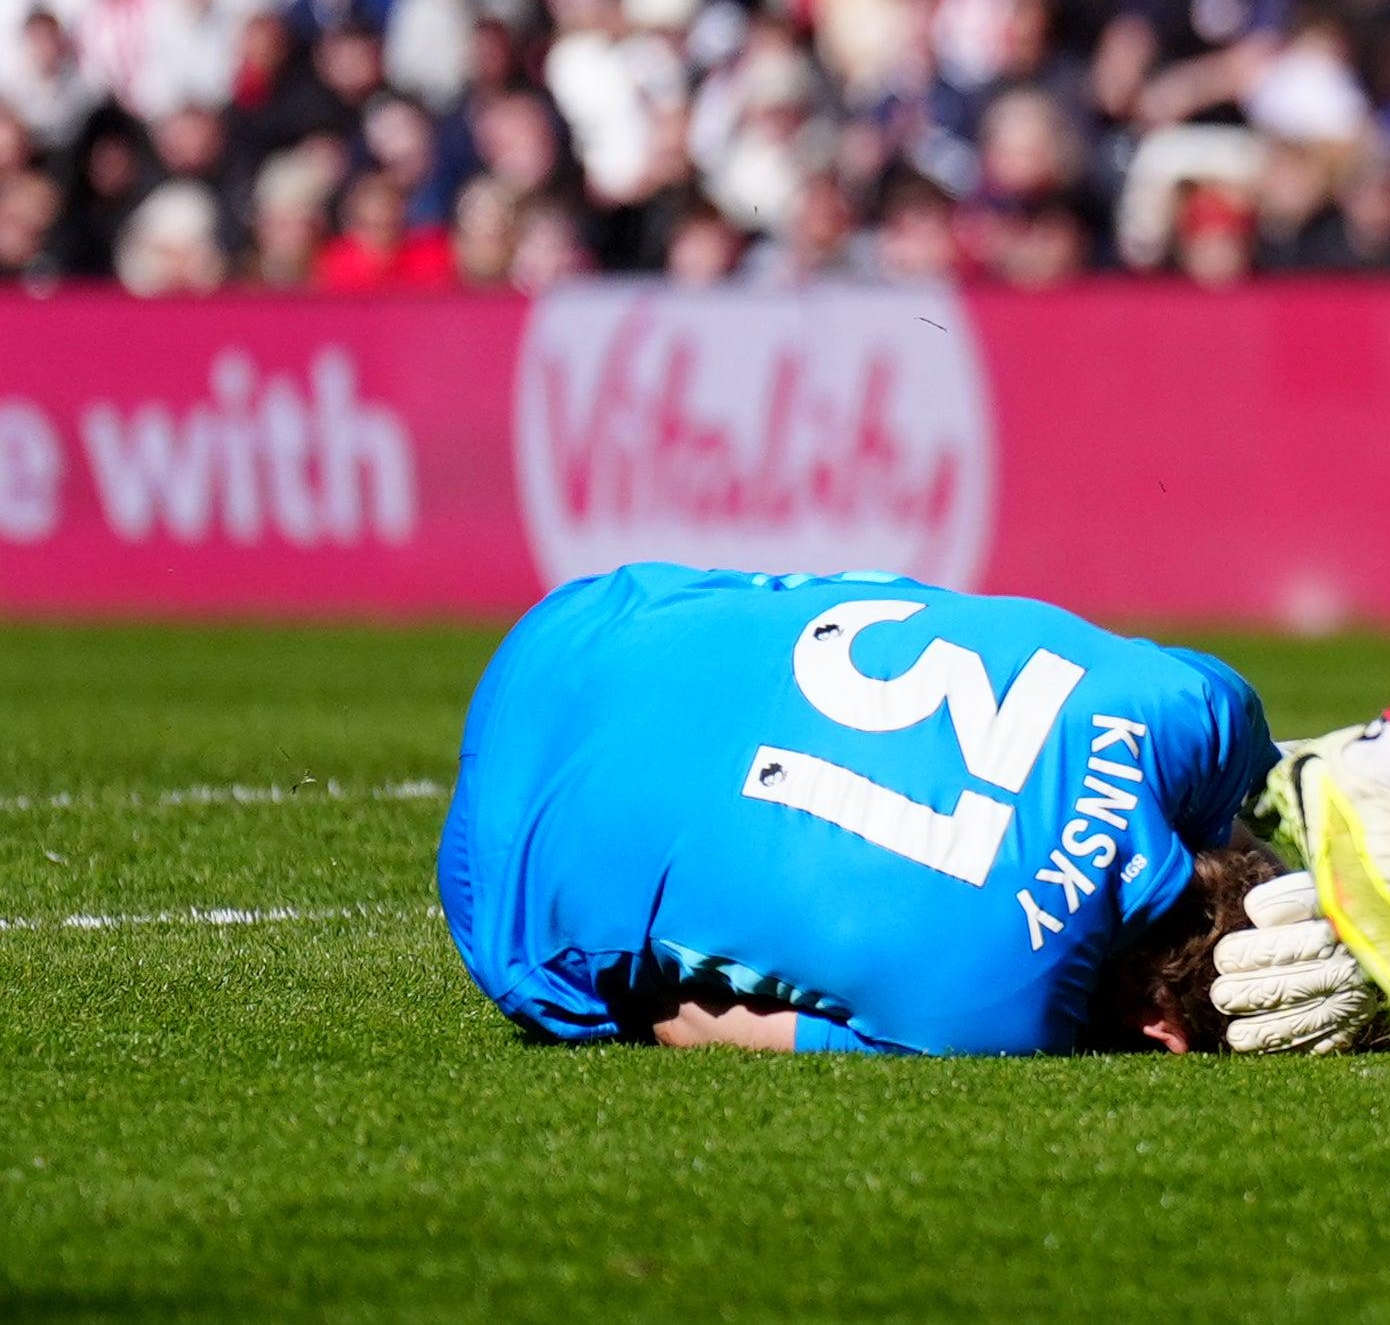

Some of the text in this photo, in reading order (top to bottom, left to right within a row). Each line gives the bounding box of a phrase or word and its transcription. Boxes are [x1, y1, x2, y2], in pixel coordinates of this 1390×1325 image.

[84, 344, 412, 547] with
[741, 599, 1088, 888] 31
[1015, 714, 1147, 951] KINSKY
